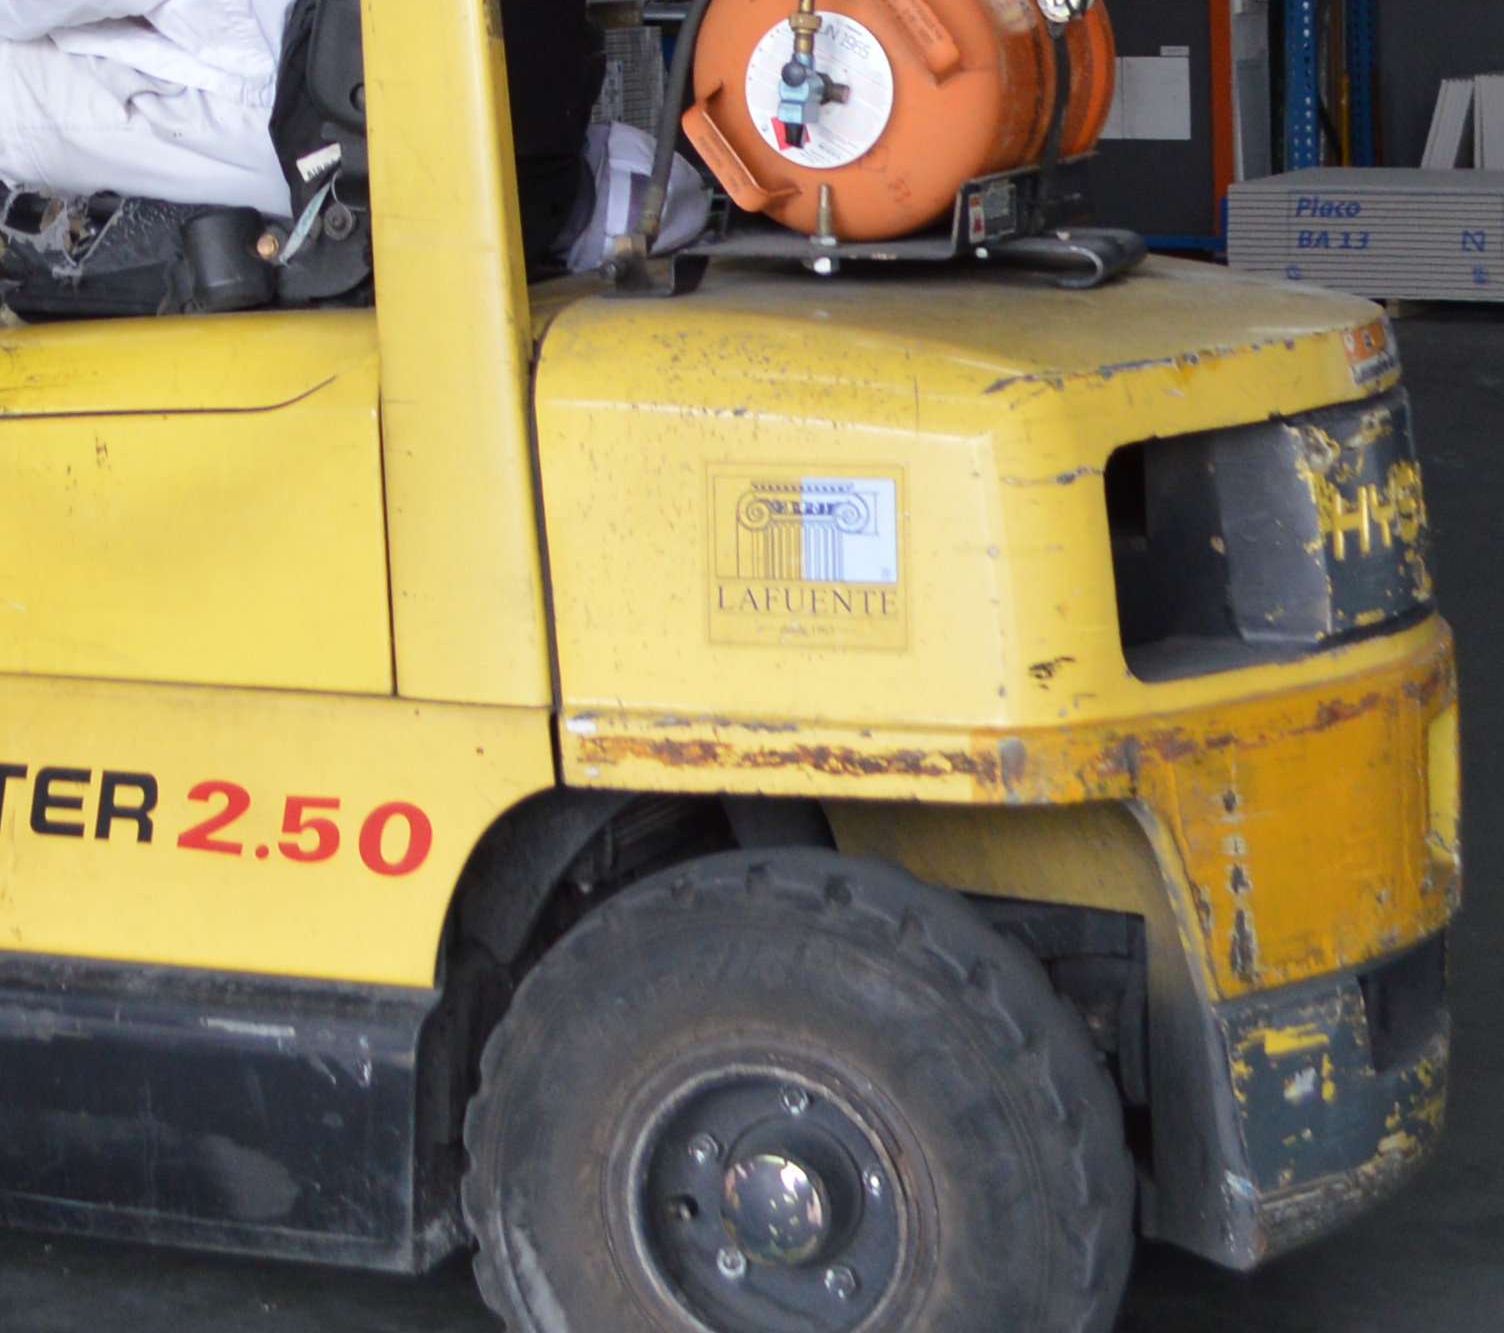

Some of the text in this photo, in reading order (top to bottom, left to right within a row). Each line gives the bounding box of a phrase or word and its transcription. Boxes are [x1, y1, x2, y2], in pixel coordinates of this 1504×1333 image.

[1296, 196, 1362, 220] Placo
[1296, 230, 1371, 251] BA 13
[717, 585, 899, 617] LAFUENTE
[176, 778, 435, 879] 2.50
